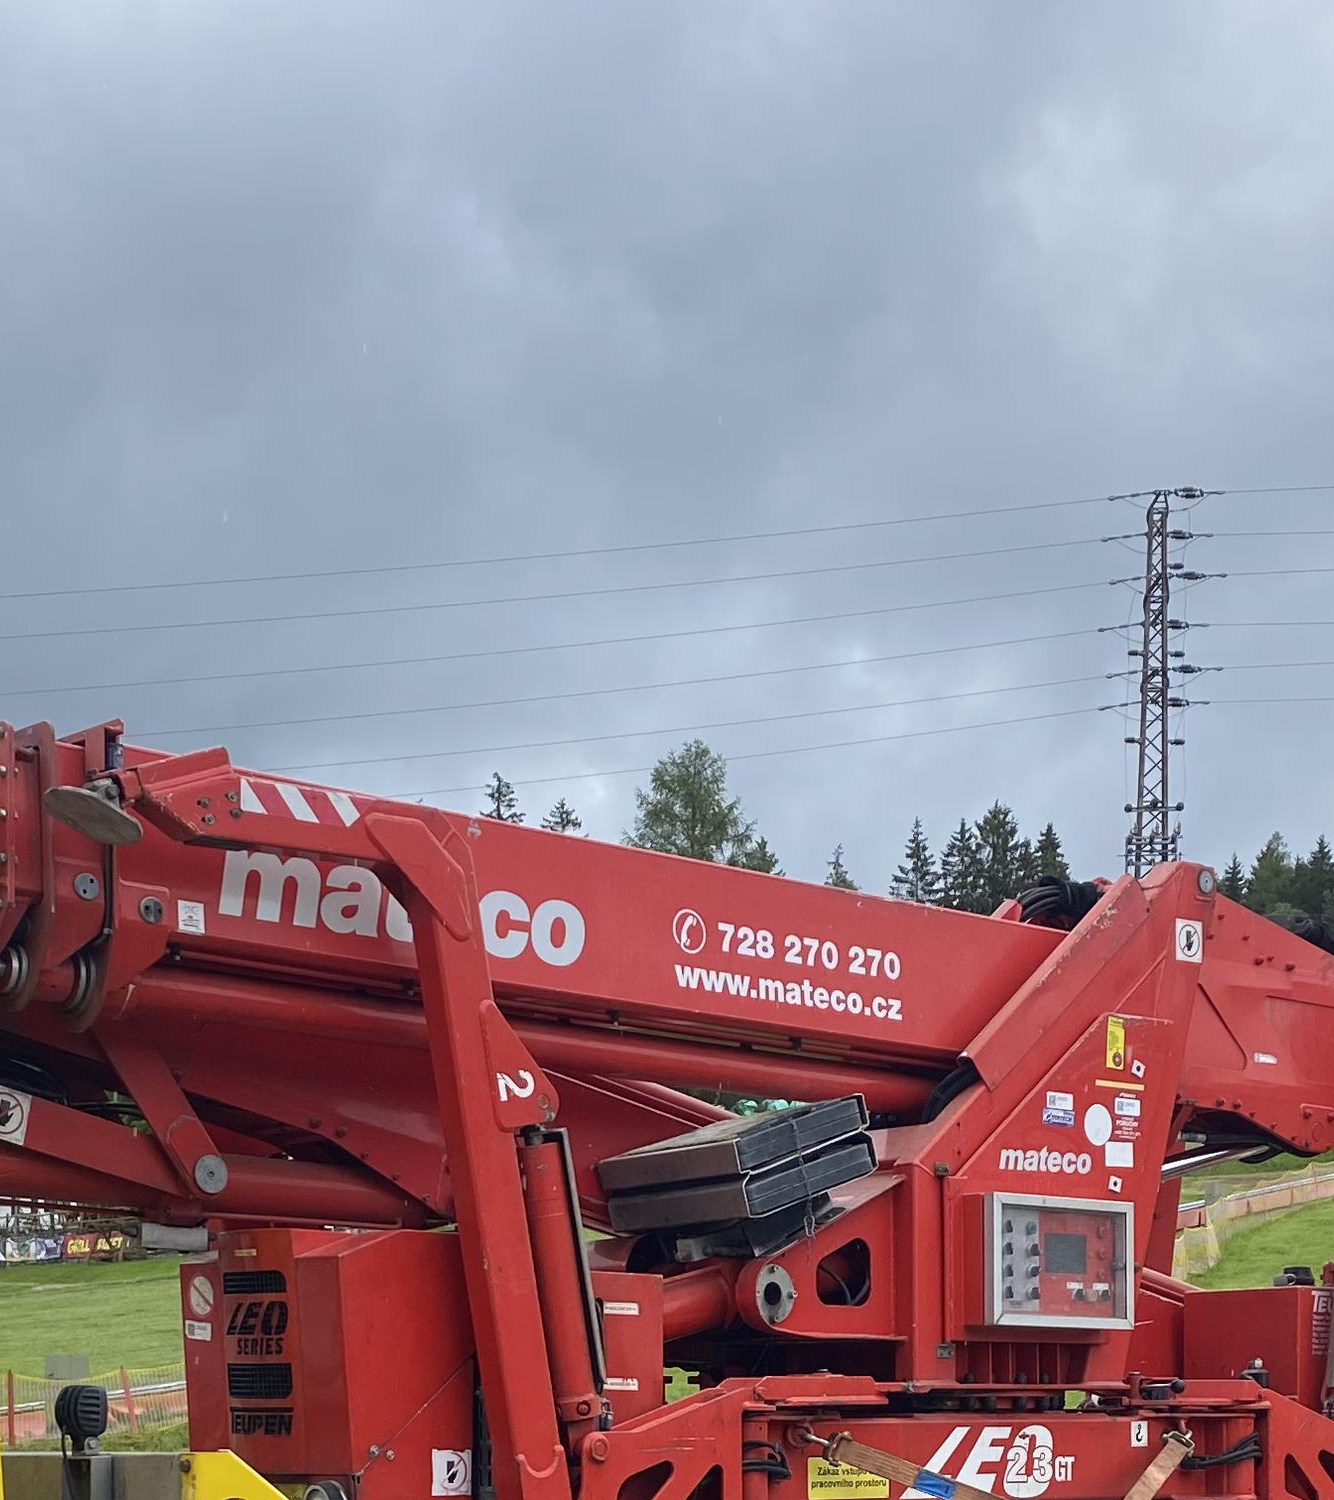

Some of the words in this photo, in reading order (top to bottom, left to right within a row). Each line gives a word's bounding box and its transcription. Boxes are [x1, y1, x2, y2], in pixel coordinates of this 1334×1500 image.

[218, 849, 585, 967] maco
[717, 922, 774, 959] 728
[784, 935, 839, 970] 270
[848, 946, 901, 980] 270
[674, 964, 903, 1021] www.mateco.cz
[496, 1069, 534, 1102] 2
[999, 1146, 1092, 1174] mateco
[226, 1301, 289, 1336] LEO
[237, 1337, 284, 1355] SERIES
[230, 1407, 294, 1436] TEUPEN
[817, 1466, 839, 1475] Zákaz
[855, 1480, 887, 1489] prostoru
